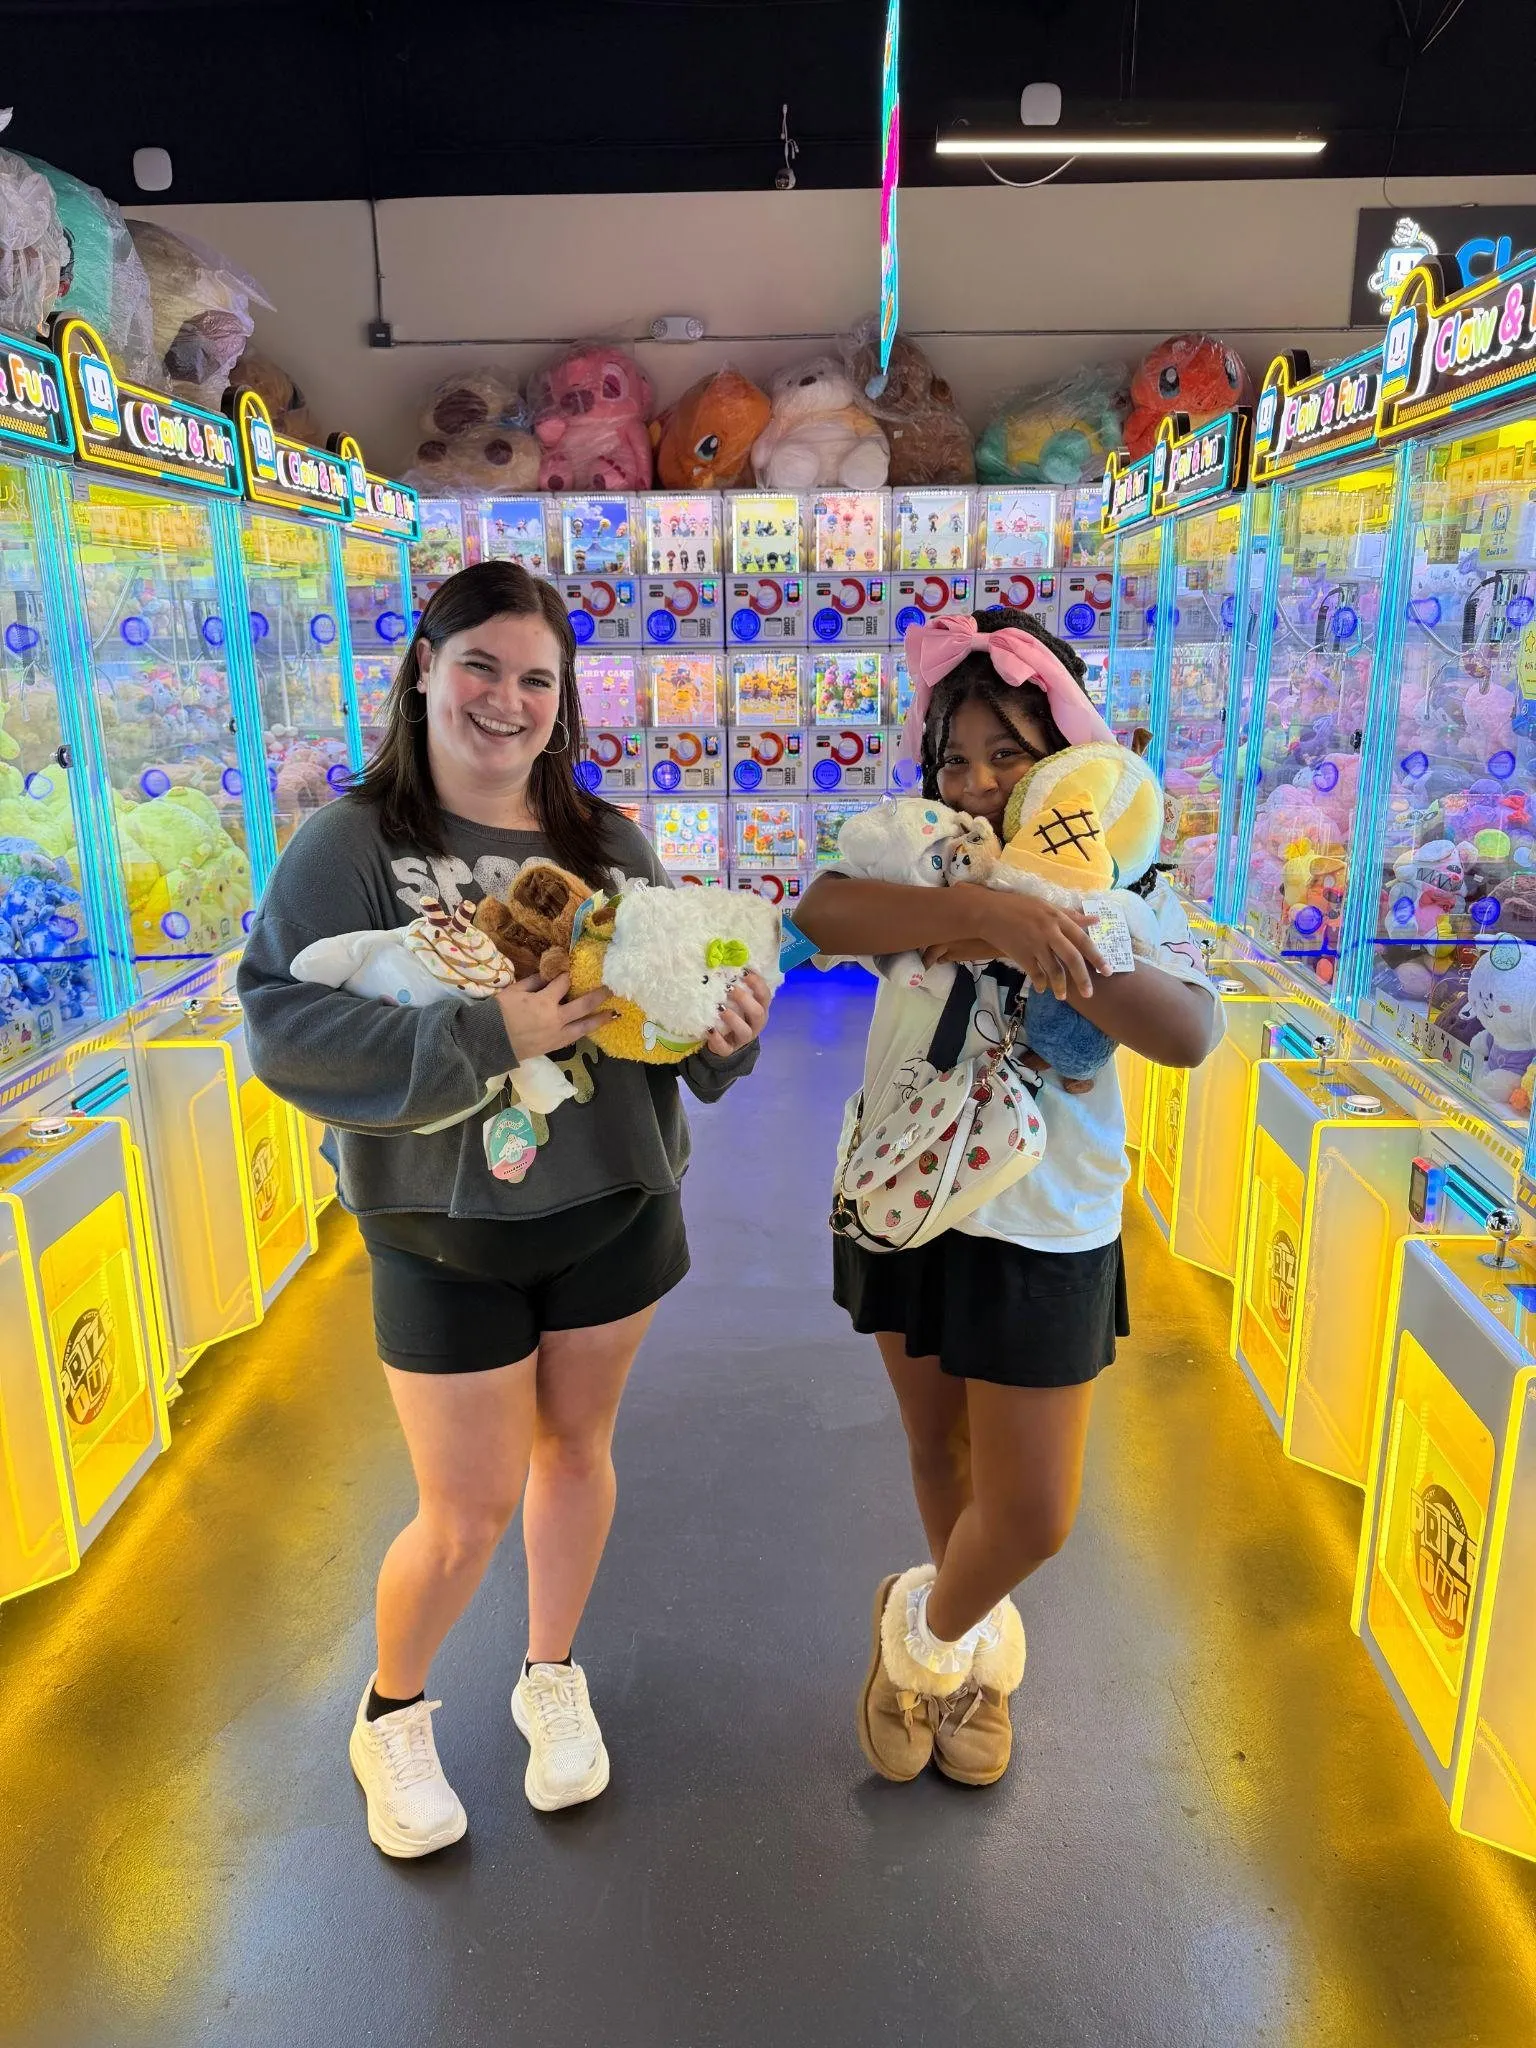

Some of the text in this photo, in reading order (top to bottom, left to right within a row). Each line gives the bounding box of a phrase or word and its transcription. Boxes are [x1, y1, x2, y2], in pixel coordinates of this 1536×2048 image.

[1455, 236, 1530, 288] Cl
[1435, 306, 1498, 373] Claw
[1499, 283, 1526, 345] &
[8, 353, 60, 413] Fun
[1285, 374, 1368, 440] Claw & Fun
[141, 402, 235, 467] Claw & Fun
[289, 452, 319, 489] Claw
[319, 461, 331, 493] &
